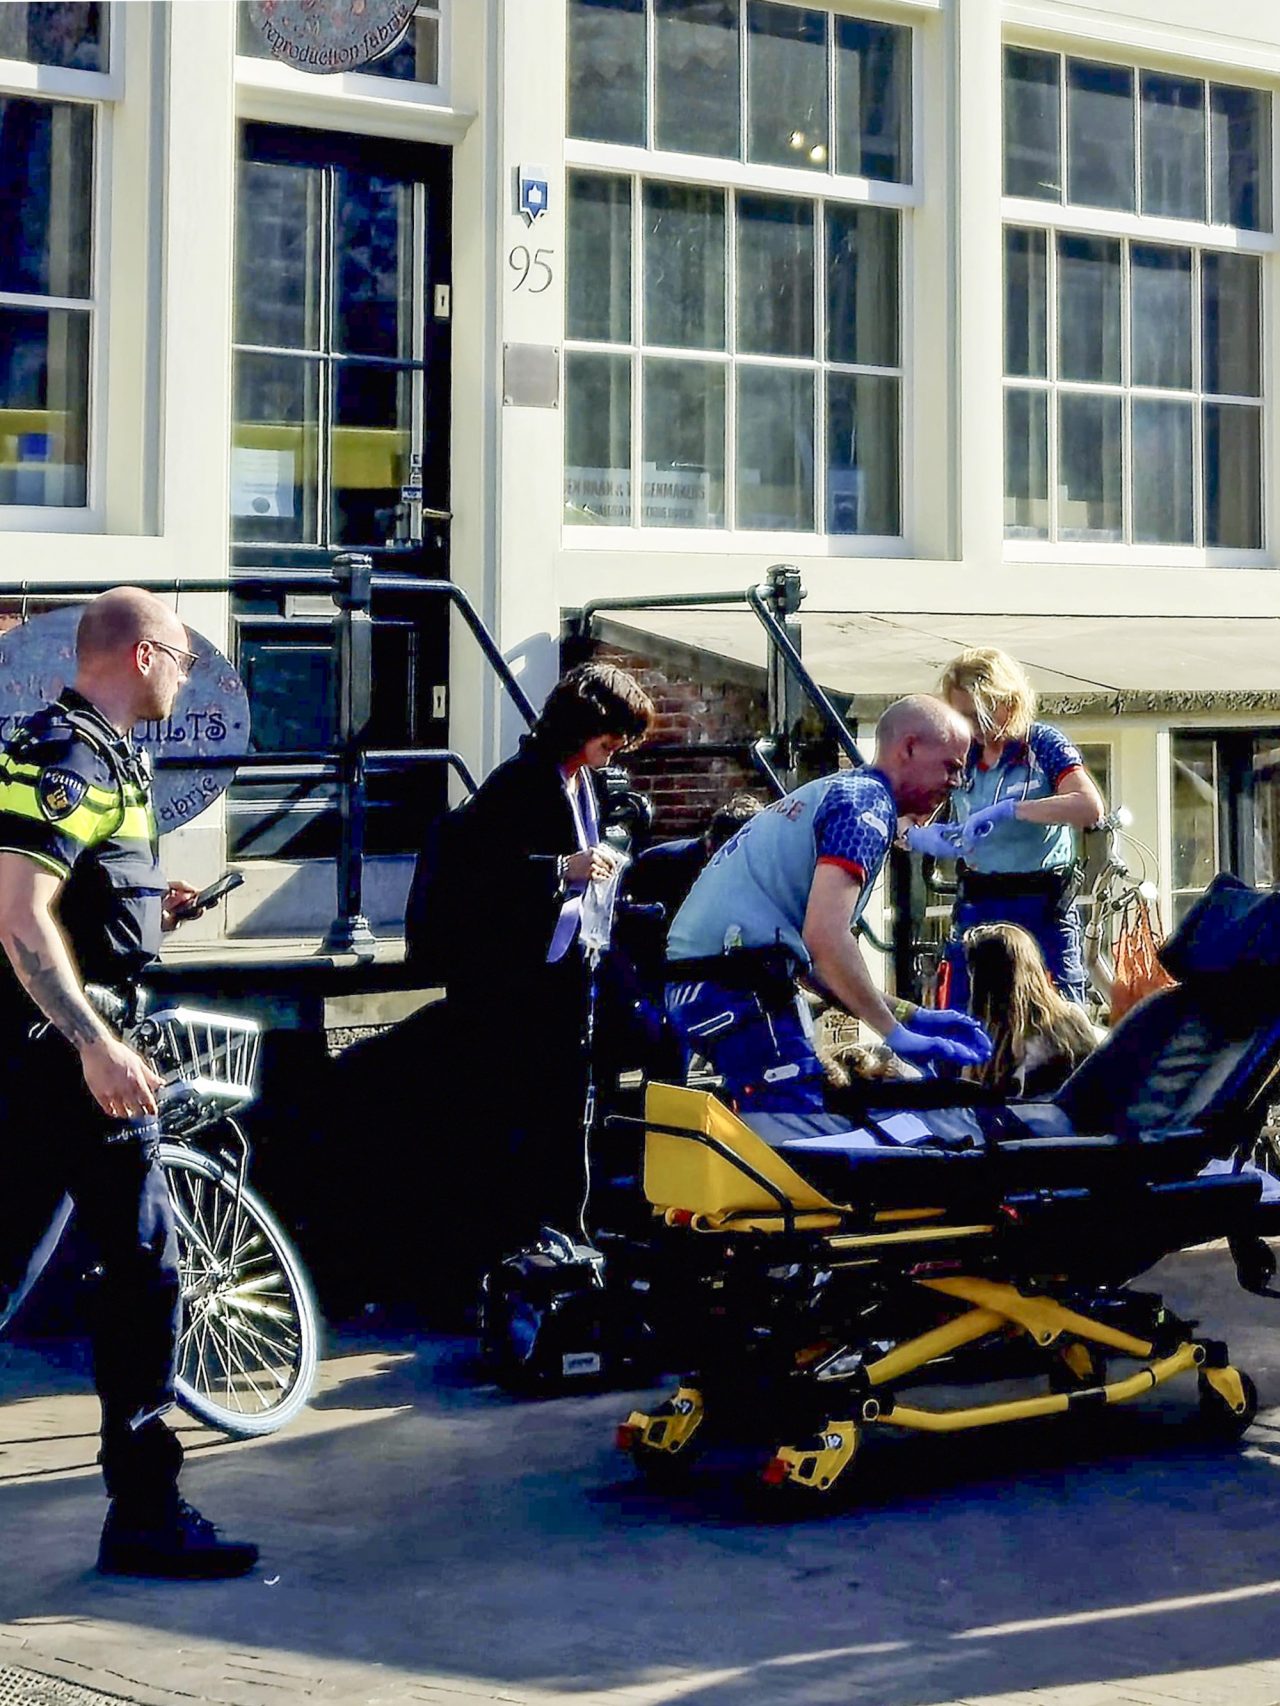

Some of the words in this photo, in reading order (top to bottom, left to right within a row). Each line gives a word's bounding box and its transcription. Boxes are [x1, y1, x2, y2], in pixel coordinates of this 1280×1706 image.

[261, 18, 359, 65] reproduction
[509, 245, 554, 293] 95
[134, 711, 227, 743] UILTS
[45, 771, 83, 791] POLITIE
[160, 776, 219, 822] abric
